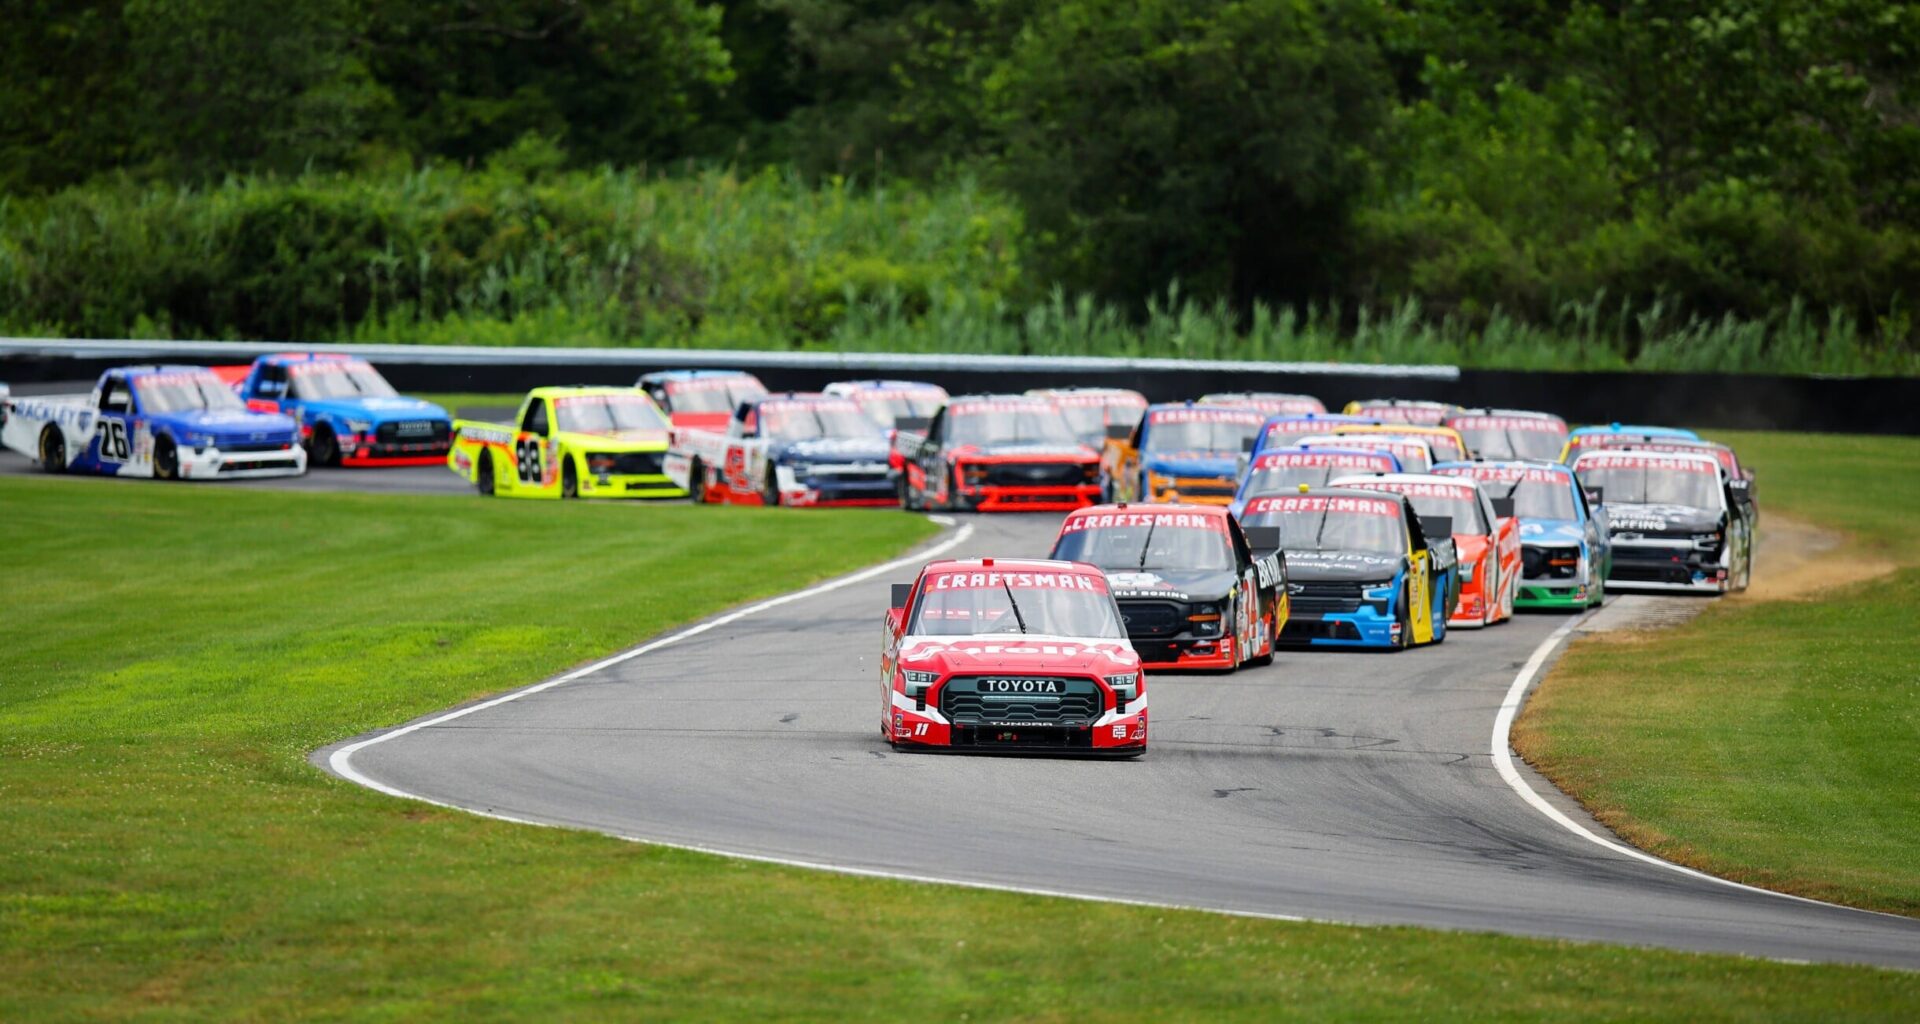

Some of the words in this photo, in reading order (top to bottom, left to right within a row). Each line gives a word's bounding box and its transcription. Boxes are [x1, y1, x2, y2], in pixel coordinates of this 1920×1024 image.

[97, 418, 131, 461] 26
[1265, 454, 1384, 468] CRAFTSMAN
[1587, 457, 1705, 472] CRAFTSMAN
[1257, 498, 1388, 514] CRAFTSMAN
[1072, 514, 1207, 528] CRAFTSMAN
[1609, 519, 1667, 531] AFFING
[936, 573, 1094, 590] CRAFTSMAN
[1141, 590, 1189, 600] BOXING
[987, 680, 1057, 692] TOYOTA
[914, 722, 929, 736] 11
